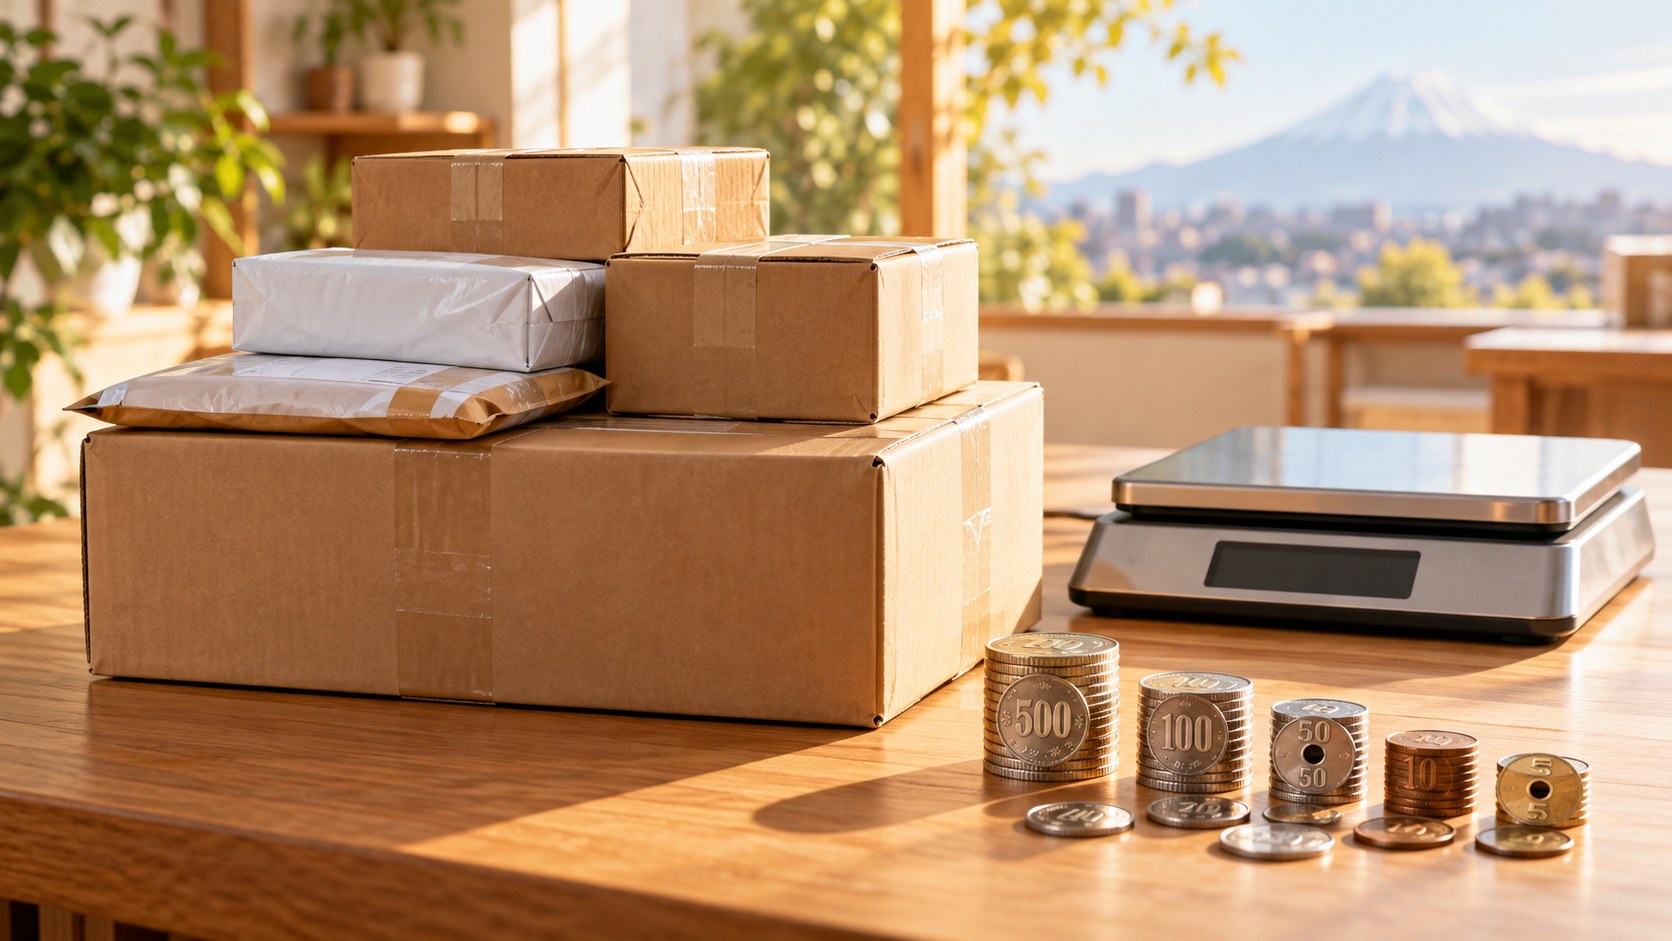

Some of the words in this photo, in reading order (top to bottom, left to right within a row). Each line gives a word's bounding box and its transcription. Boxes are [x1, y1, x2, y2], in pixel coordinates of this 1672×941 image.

[1014, 698, 1072, 738] 500
[1161, 713, 1212, 752] 100
[1297, 720, 1331, 743] 50
[1299, 767, 1327, 788] 50
[1403, 755, 1437, 790] 10
[1531, 757, 1552, 776] 5
[1527, 802, 1548, 820] 5
